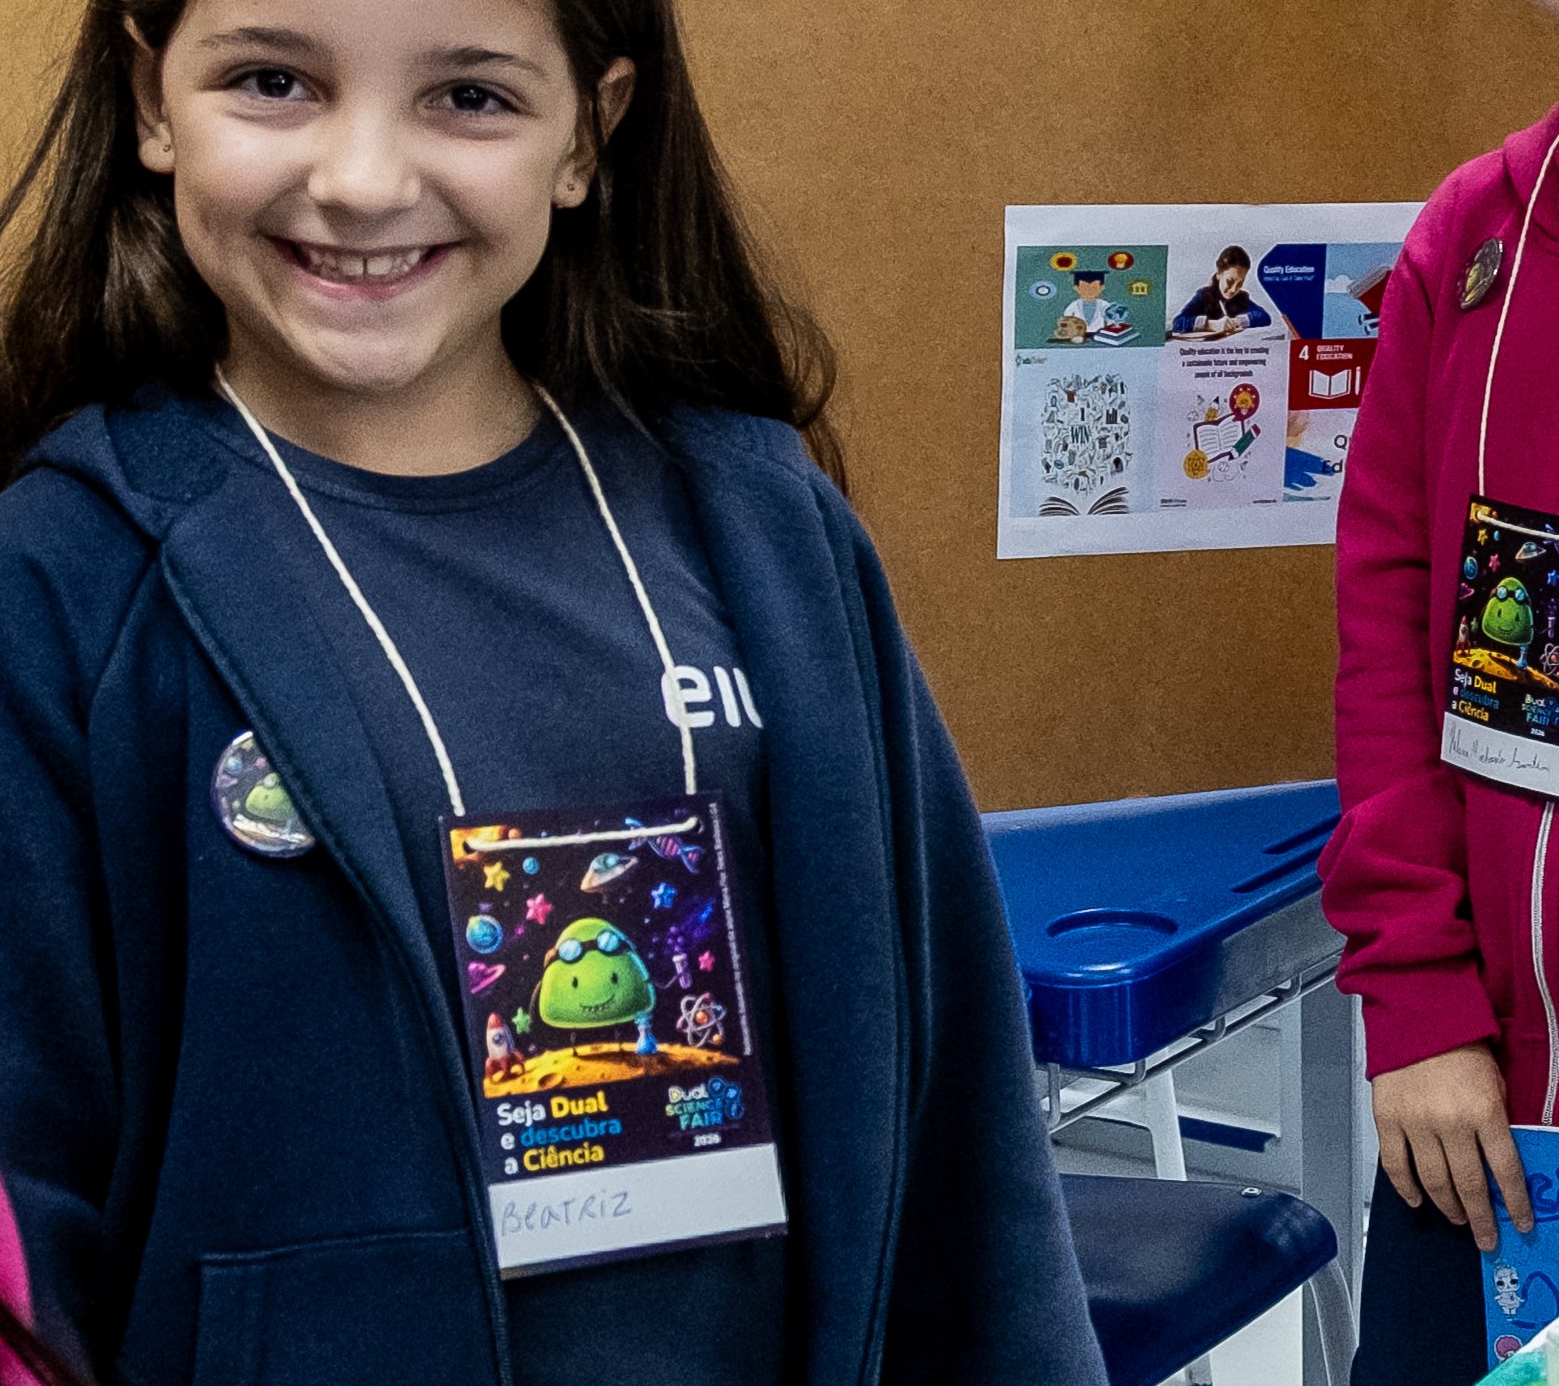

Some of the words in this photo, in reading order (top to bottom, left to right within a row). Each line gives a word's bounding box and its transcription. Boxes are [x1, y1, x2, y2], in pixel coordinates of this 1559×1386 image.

[1299, 345, 1309, 360] 4
[1474, 676, 1497, 693] Dual
[497, 1100, 546, 1127] Seja
[550, 1091, 609, 1119] Dual
[679, 1111, 724, 1130] FAIR
[501, 1132, 515, 1150] e
[520, 1116, 623, 1147] descubra
[504, 1157, 518, 1175] a
[523, 1142, 605, 1171] Ciência
